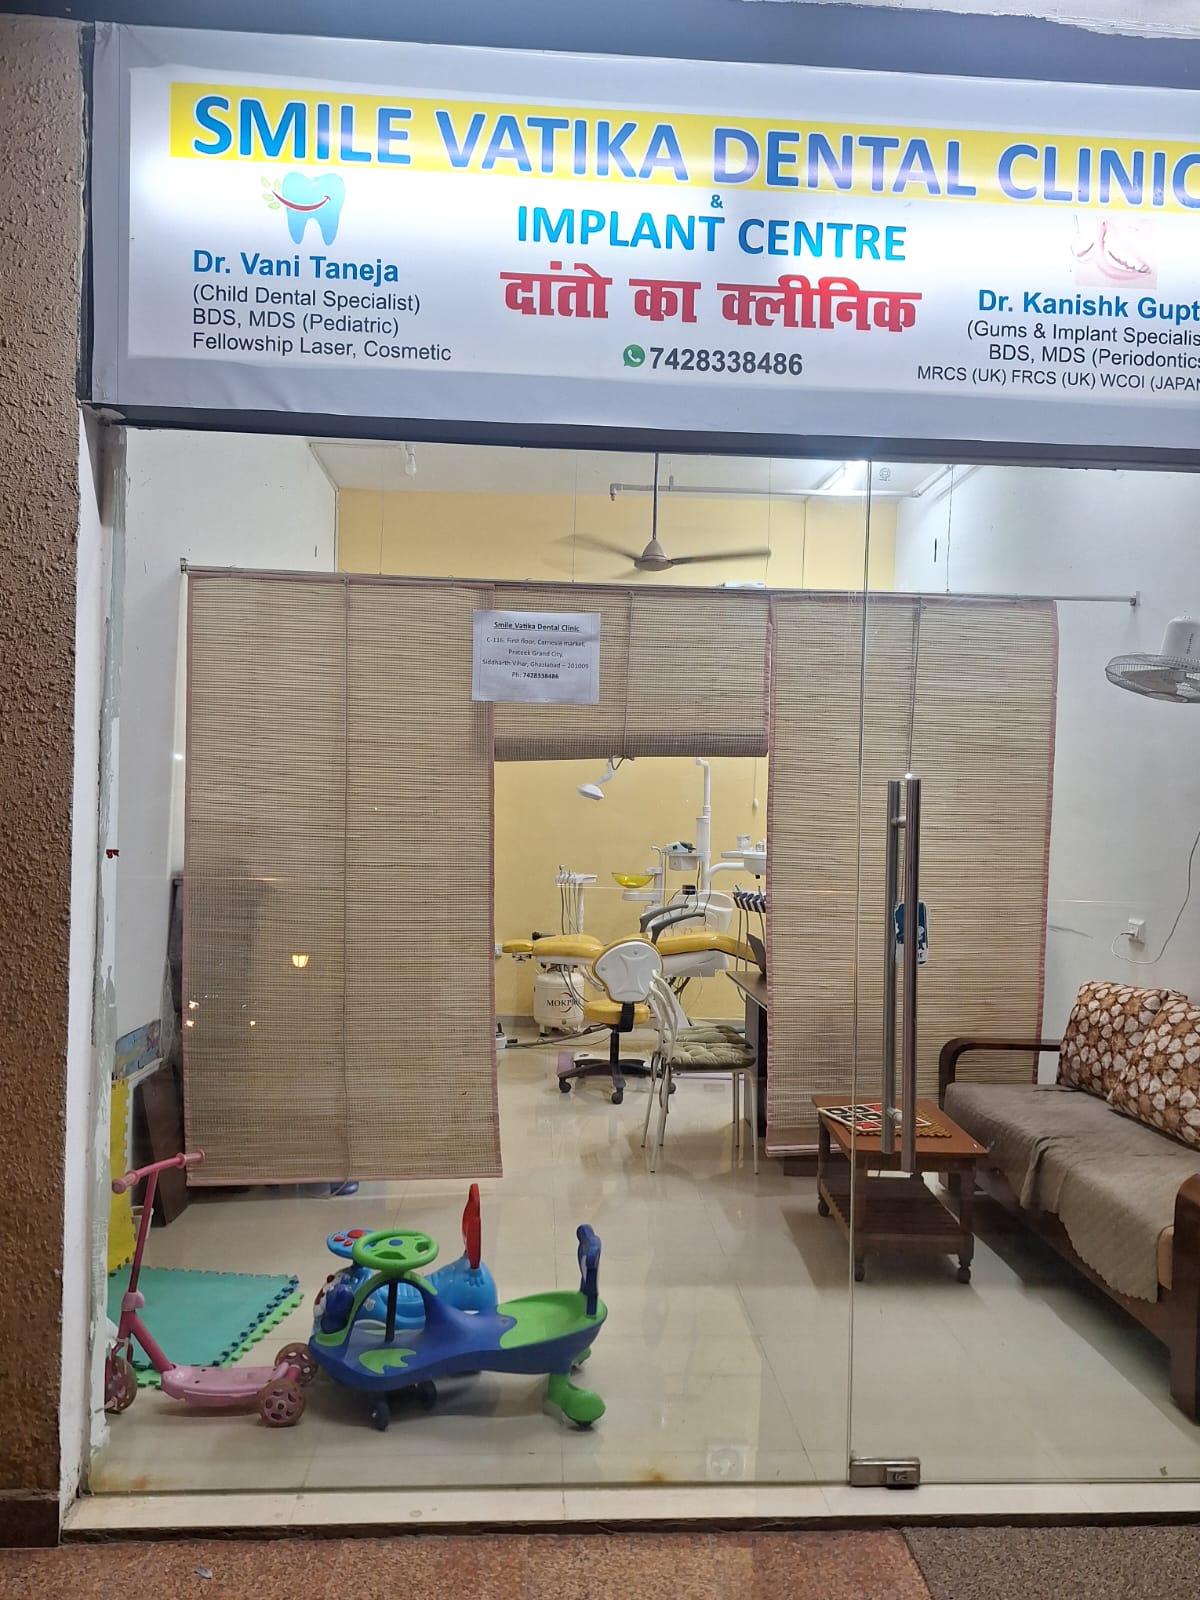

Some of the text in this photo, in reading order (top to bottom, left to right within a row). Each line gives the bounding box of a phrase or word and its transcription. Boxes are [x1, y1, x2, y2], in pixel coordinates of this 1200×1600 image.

[193, 95, 1200, 208] SMILE VATIKA DENTAL CLINIC
[710, 194, 724, 209] &
[518, 205, 907, 261] IMPLANT CENTRE
[193, 249, 399, 288] Dr. Vani Taneja
[193, 283, 421, 315] (Child Dental Specialist)
[500, 260, 922, 333] दांतो का क्लीनिक
[978, 289, 1014, 312] Dr.
[1023, 291, 1129, 318] Kanishk
[193, 308, 400, 338] BDS, MDS (Pediatric)
[967, 319, 1028, 340] (Gums
[1033, 322, 1047, 339] &
[1052, 323, 1118, 344] Implant
[193, 332, 452, 361] Fellowship Laser, Cosmetic
[649, 346, 803, 376] 7428338486
[989, 343, 1036, 364] BDS,
[1042, 346, 1086, 363] MDS
[917, 365, 967, 382] MRCS
[972, 367, 1007, 386] (UK)
[1011, 369, 1057, 385] FRCS
[1061, 371, 1096, 389] (UK)
[1100, 373, 1145, 389] WCOI
[494, 621, 580, 632] Smile Vatika Dental Clinic
